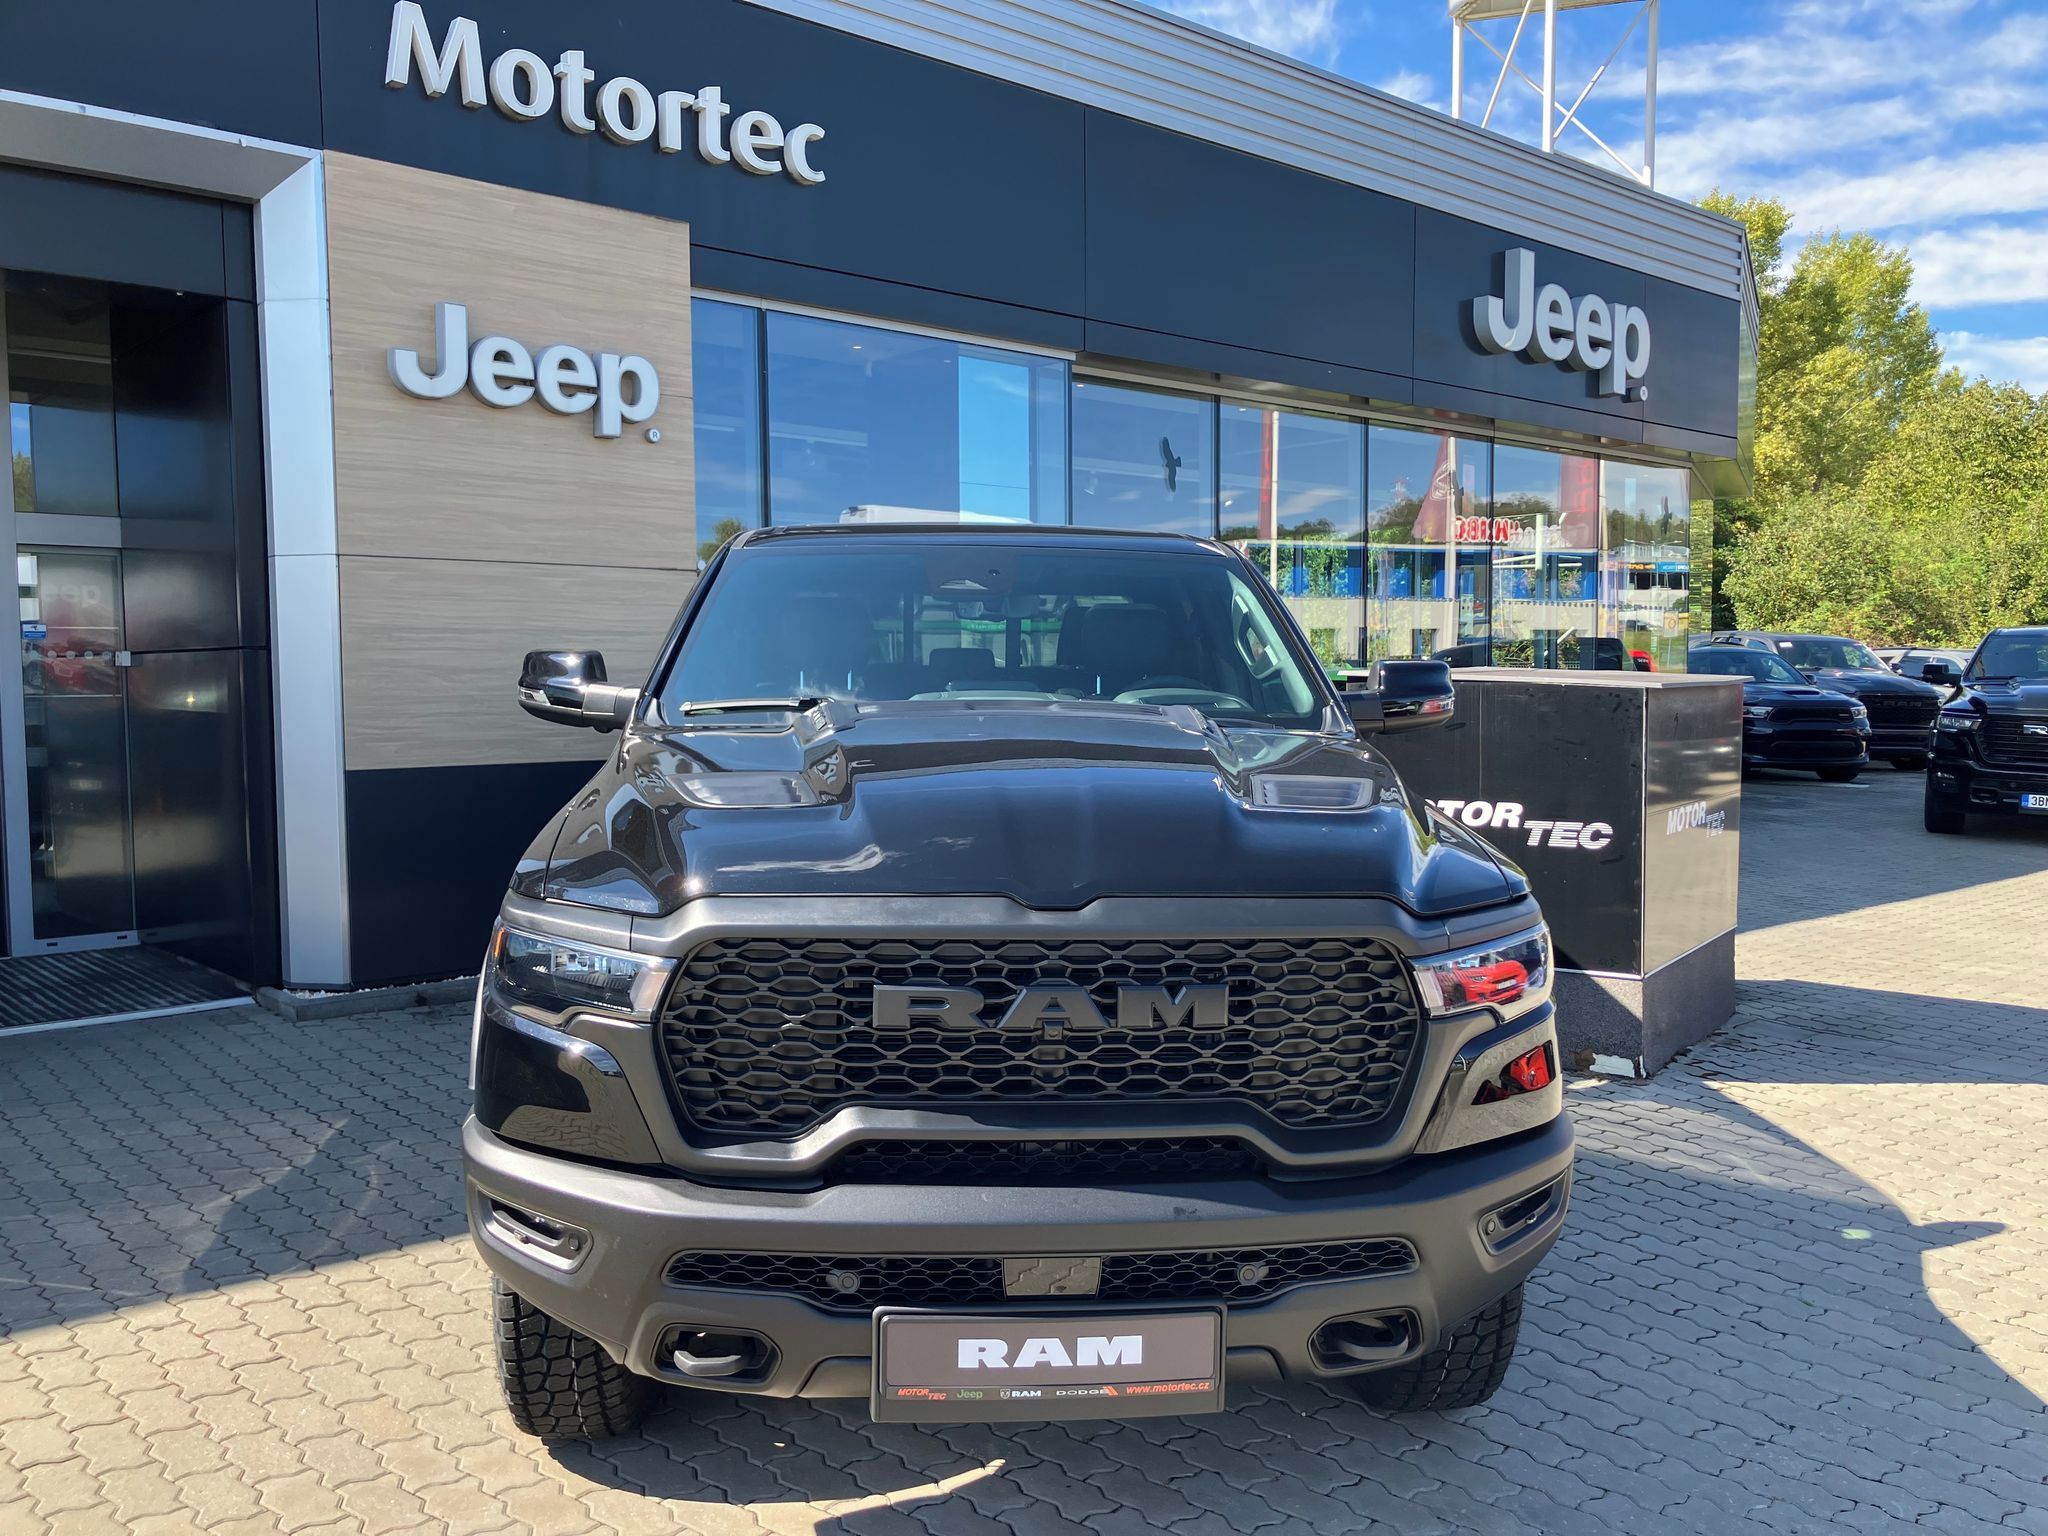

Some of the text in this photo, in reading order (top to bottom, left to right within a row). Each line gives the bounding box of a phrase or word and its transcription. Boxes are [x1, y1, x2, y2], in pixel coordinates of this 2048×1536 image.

[385, 0, 826, 185] Motortec
[1473, 247, 1651, 396] Jeep
[387, 302, 660, 438] Jeep
[872, 983, 1230, 1029] RAM
[956, 1389, 983, 1400] Jeep
[1011, 1390, 1042, 1398] RAM
[1126, 1382, 1210, 1395] www.motortec.cz
[957, 1335, 1143, 1369] RAM
